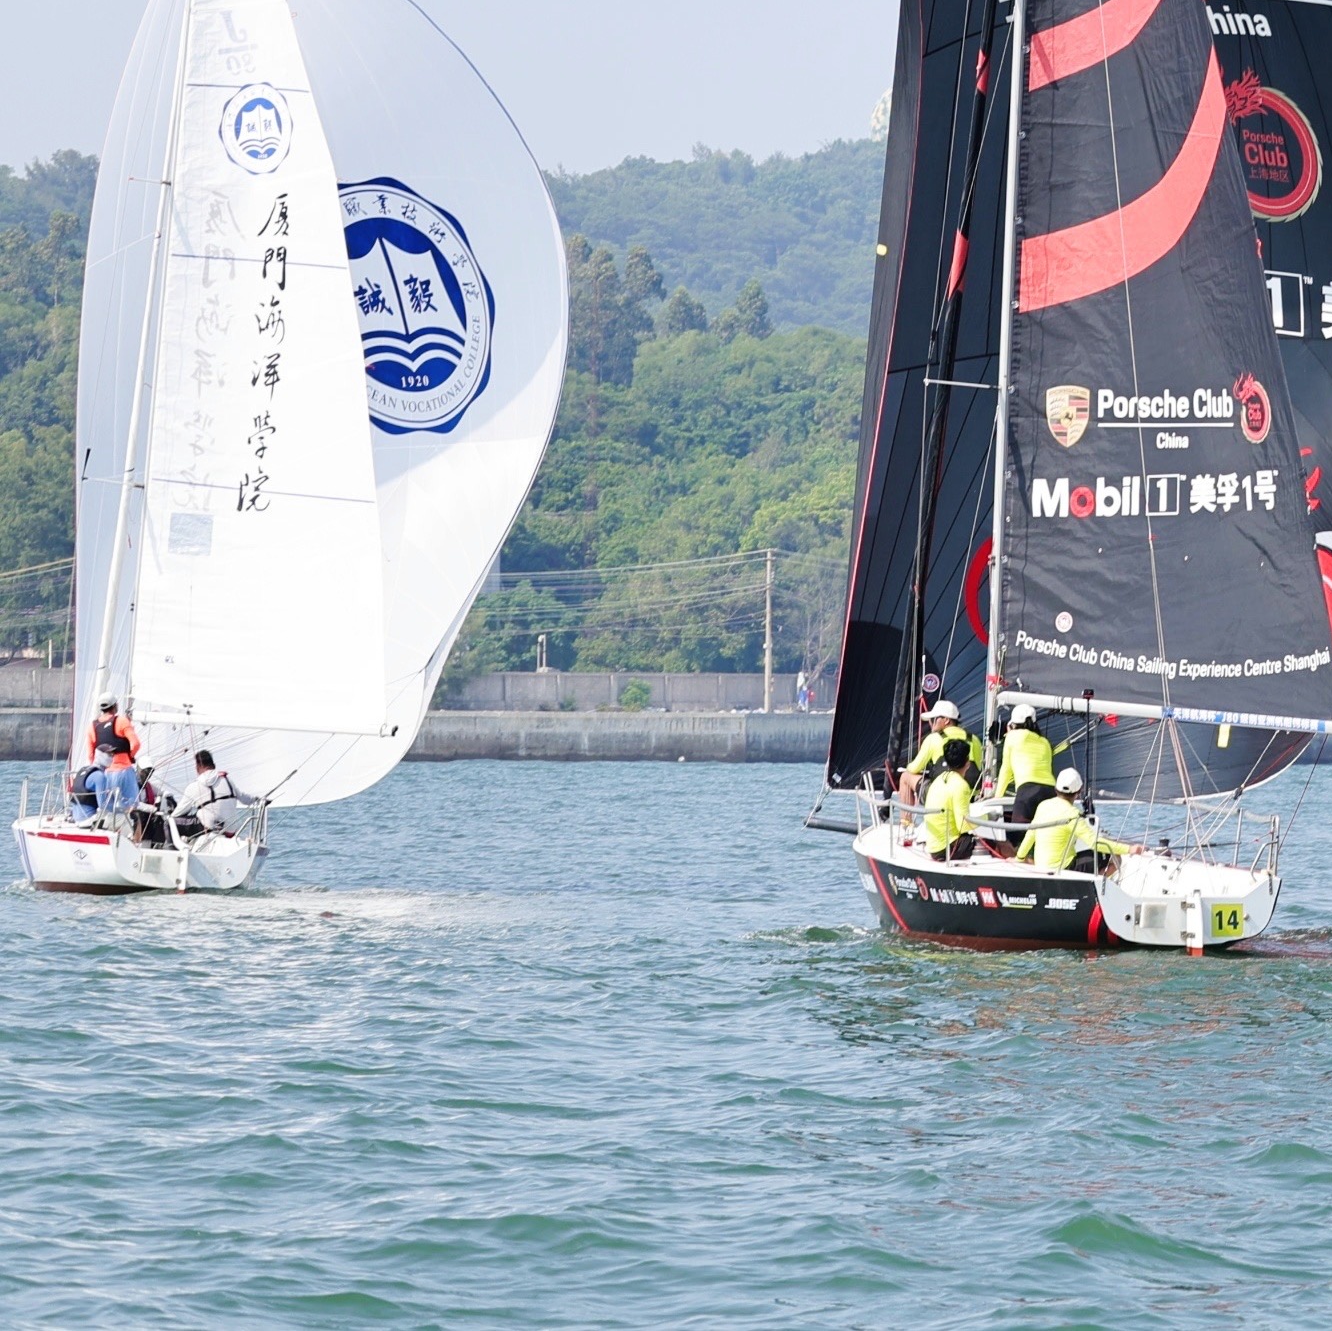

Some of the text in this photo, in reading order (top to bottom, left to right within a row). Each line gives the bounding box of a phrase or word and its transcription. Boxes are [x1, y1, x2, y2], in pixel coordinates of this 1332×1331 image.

[1206, 5, 1272, 37] hina
[1242, 129, 1285, 146] Porsche
[1244, 143, 1289, 168] Club
[365, 314, 481, 414] CEAN VOCATIONAL COLLEGE
[401, 374, 430, 389] 1920
[1097, 388, 1234, 419] Porsche Club
[1155, 432, 1190, 449] China
[1031, 476, 1140, 518] Mobil
[1189, 470, 1277, 514] 美孚1号
[1015, 630, 1331, 681] Porsche Club China Sailing Experience Centre Shanghai
[1214, 908, 1242, 932] 14
